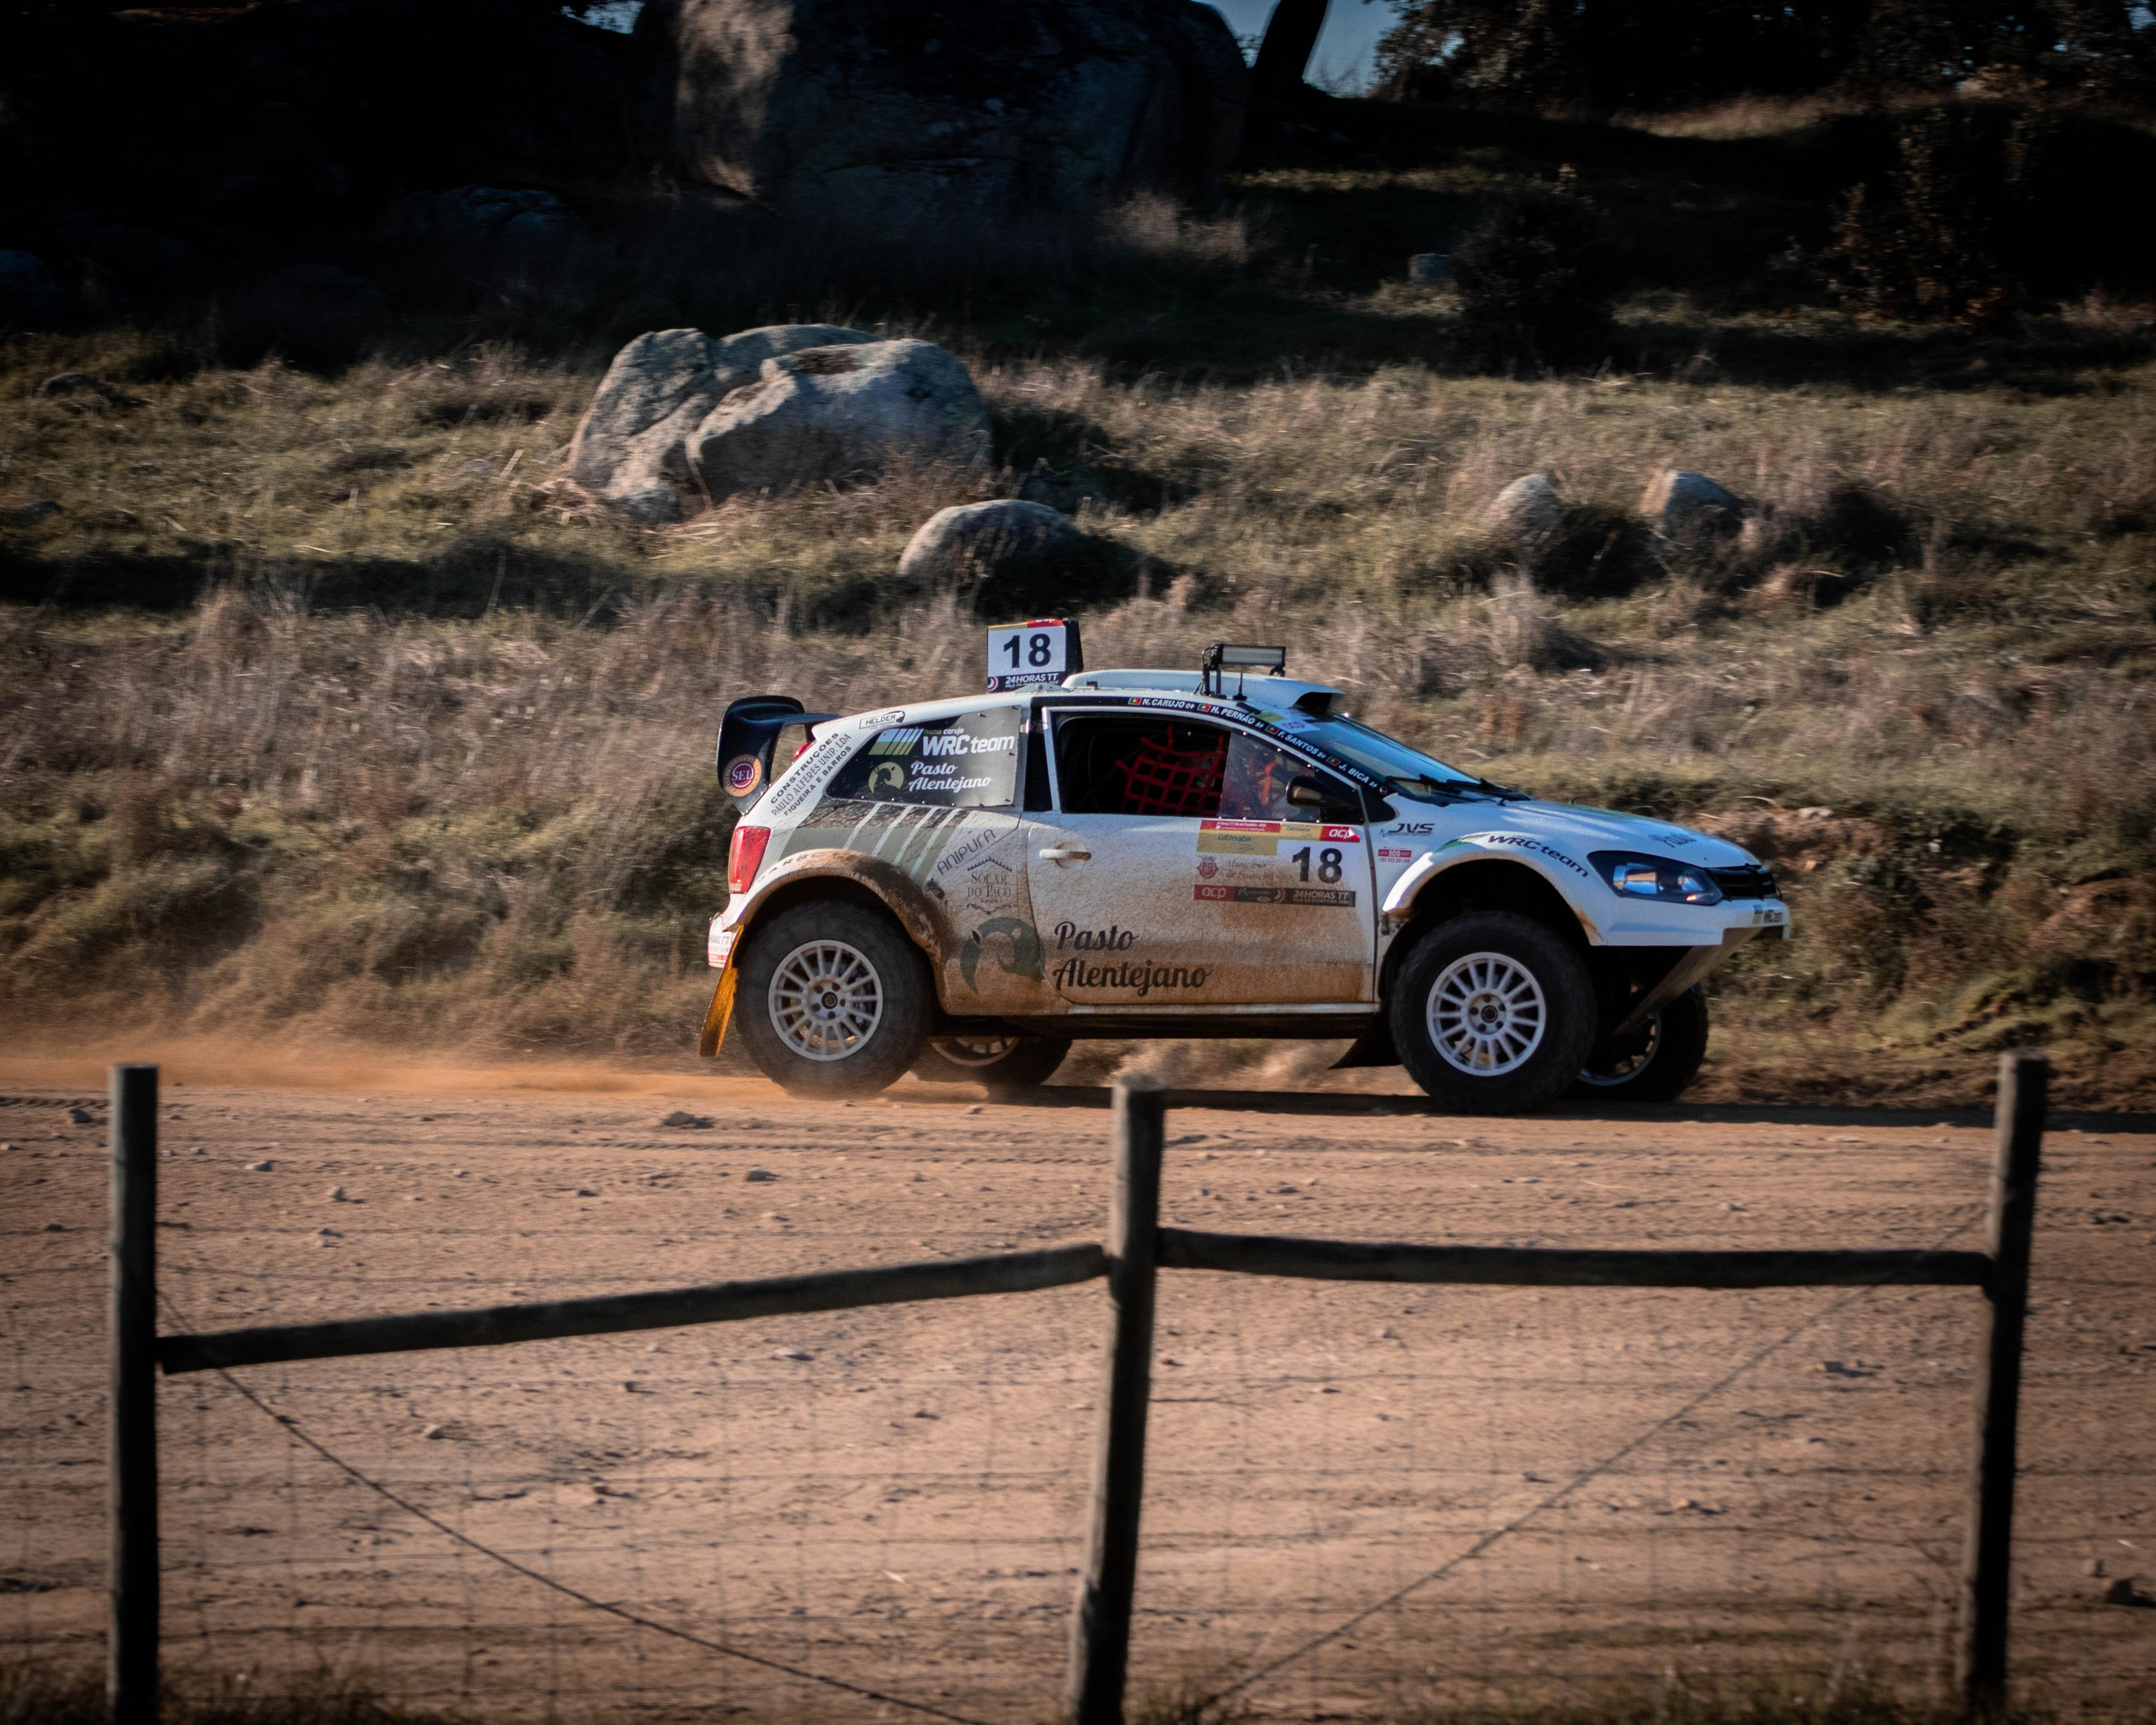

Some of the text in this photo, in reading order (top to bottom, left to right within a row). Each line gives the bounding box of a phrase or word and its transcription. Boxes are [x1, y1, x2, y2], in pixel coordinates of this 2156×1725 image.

[1003, 633, 1051, 669] 18
[1151, 698, 1185, 708] CARUJO
[1210, 706, 1219, 714] H.
[865, 714, 896, 725] HELDER
[942, 727, 964, 735] carujo
[922, 734, 1016, 756] WRC team
[1277, 730, 1284, 739] F.
[1284, 734, 1320, 756] SANTOS
[731, 770, 752, 782] SEL
[771, 793, 794, 816] PAULO
[795, 765, 821, 795] ALFERES
[839, 733, 852, 749] LDA
[910, 761, 958, 776] Pasto
[1348, 767, 1369, 784] BICA
[784, 784, 817, 816] FIGUEIRA
[822, 745, 851, 777] BARROS
[909, 777, 993, 793] Alentejano
[1388, 823, 1435, 833] JVS
[1292, 846, 1342, 884] 18
[1488, 836, 1589, 878] WRC team
[1201, 887, 1227, 900] acp
[1337, 892, 1350, 900] TT
[1054, 921, 1139, 951] Pasto
[1053, 957, 1212, 997] Alentejano
